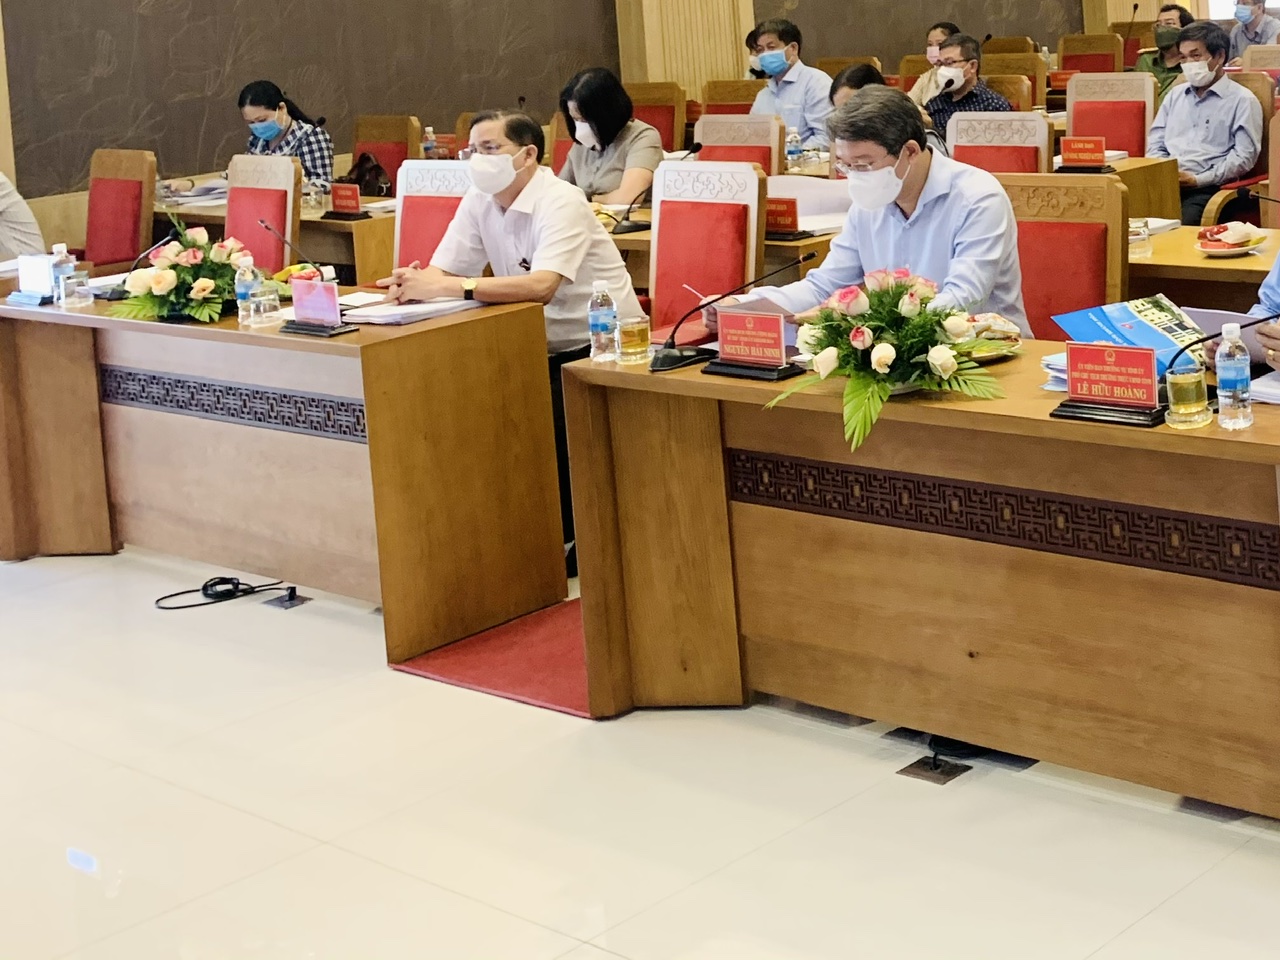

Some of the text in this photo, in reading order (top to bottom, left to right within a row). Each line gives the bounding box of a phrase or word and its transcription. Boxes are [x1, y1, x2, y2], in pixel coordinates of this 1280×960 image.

[763, 348, 781, 357] NINH
[1077, 380, 1147, 400] LÊ HỮU HOÀNG
